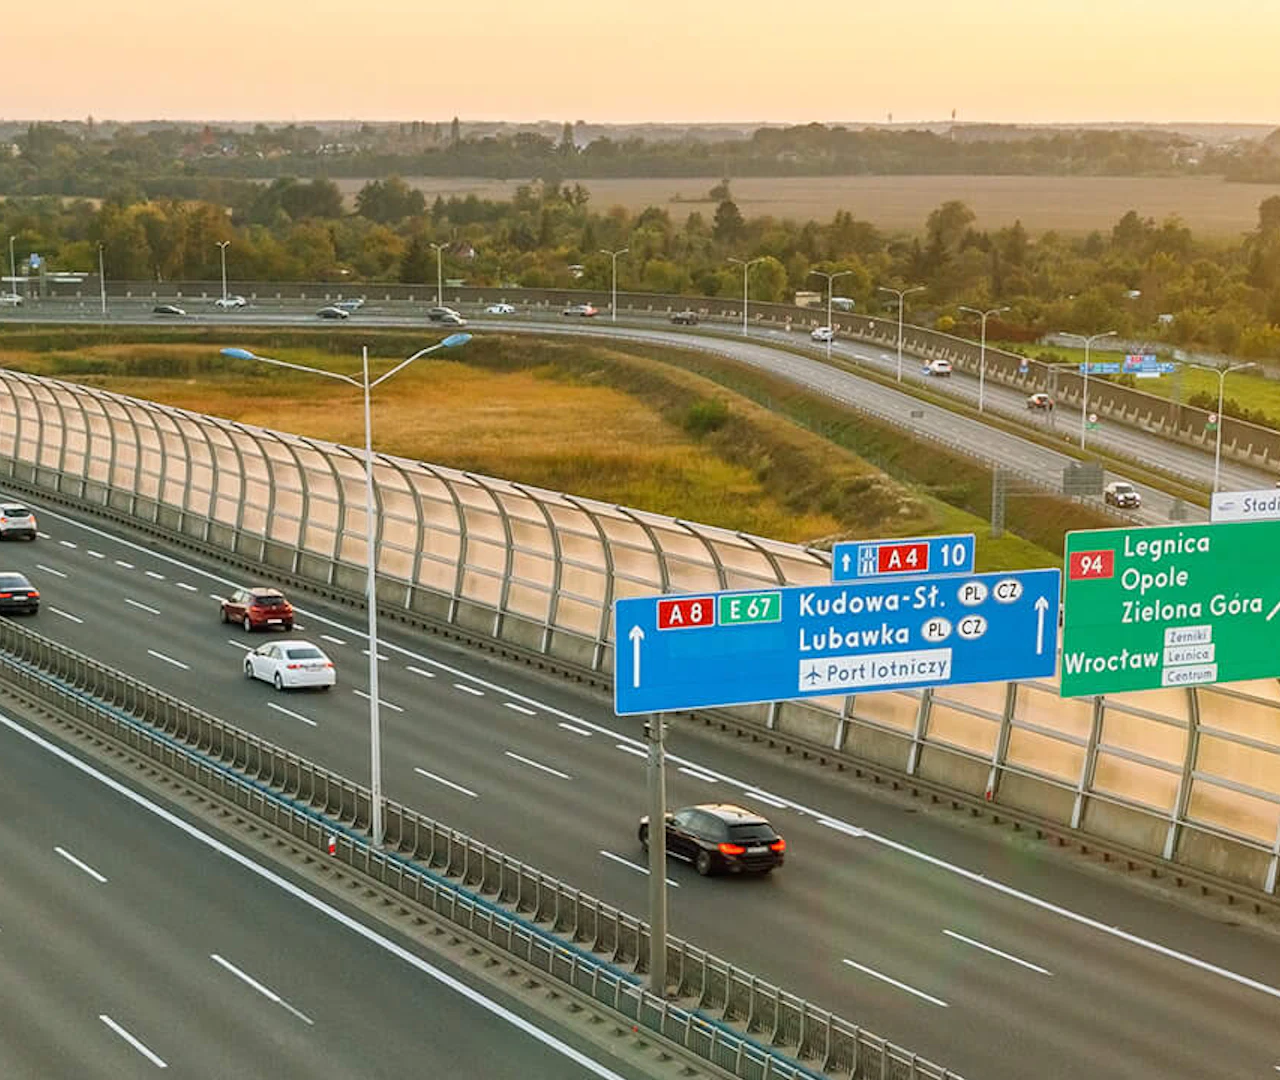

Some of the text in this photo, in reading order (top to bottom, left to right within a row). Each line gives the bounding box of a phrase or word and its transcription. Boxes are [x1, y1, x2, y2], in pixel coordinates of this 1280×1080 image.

[941, 543, 966, 567] 10
[1123, 532, 1210, 562] Legnica
[1080, 554, 1103, 575] 94
[1121, 566, 1189, 595] Opole
[798, 582, 1017, 617] Kudowa-Sł. PL CZ
[1121, 592, 1263, 624] Zielona Góra
[798, 619, 982, 652] Lubawka PL CZ
[827, 656, 948, 682] Port lotniczy
[1063, 648, 1159, 675] Wrocław
